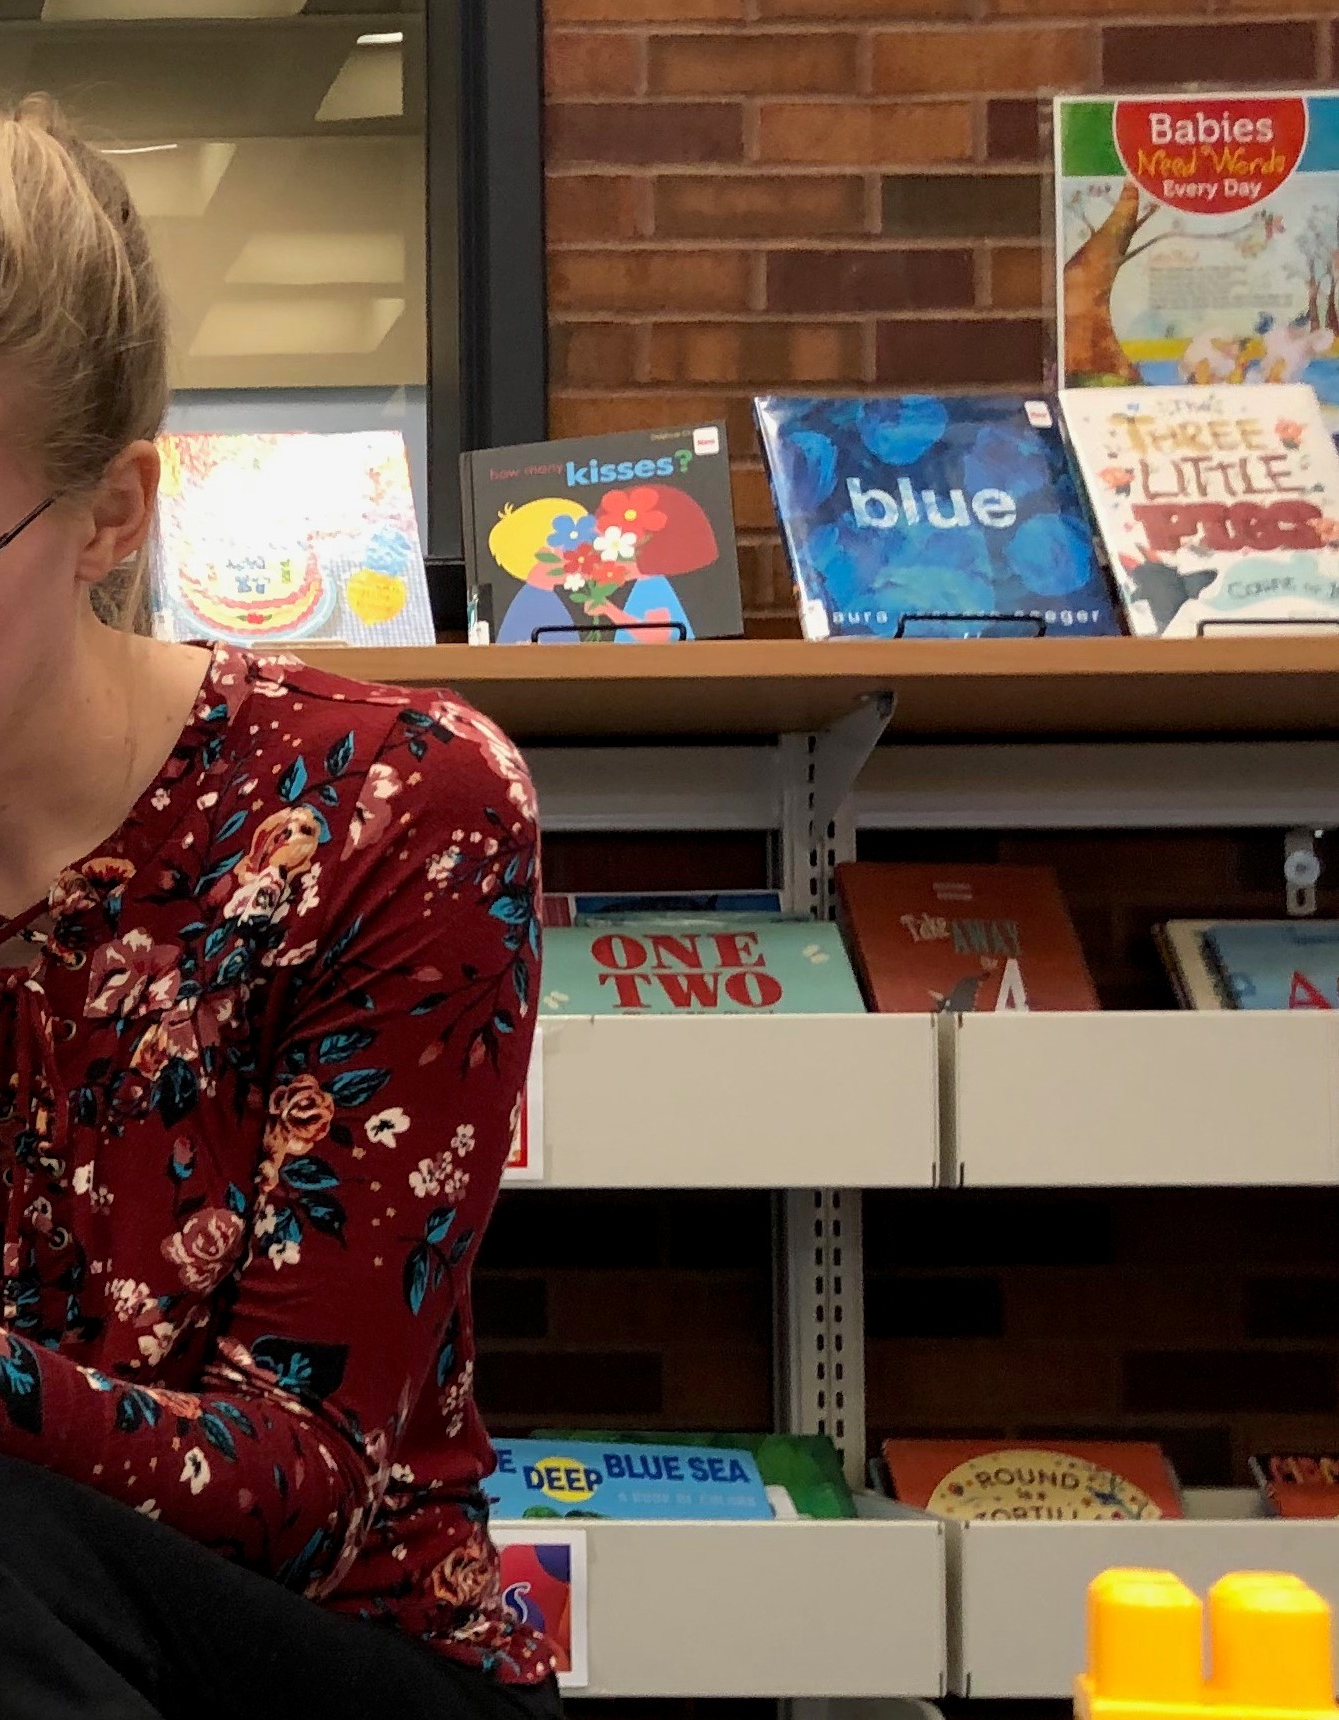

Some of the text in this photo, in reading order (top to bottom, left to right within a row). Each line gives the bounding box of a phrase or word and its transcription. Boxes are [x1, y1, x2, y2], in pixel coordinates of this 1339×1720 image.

[1149, 111, 1274, 145] Babies
[1137, 147, 1287, 178] Need Words
[1162, 178, 1262, 200] Every Day
[489, 449, 693, 487] how many kisses?
[1139, 455, 1307, 499] LITTLE
[846, 477, 1017, 529] blue
[832, 610, 888, 624] aura
[591, 932, 766, 970] ONE
[900, 911, 1020, 955] Take AWAY
[599, 970, 783, 1009] TWO
[1289, 970, 1339, 1009] A
[497, 1449, 751, 1492] E DEEP BLUE SEA
[975, 1467, 1080, 1490] ROUND
